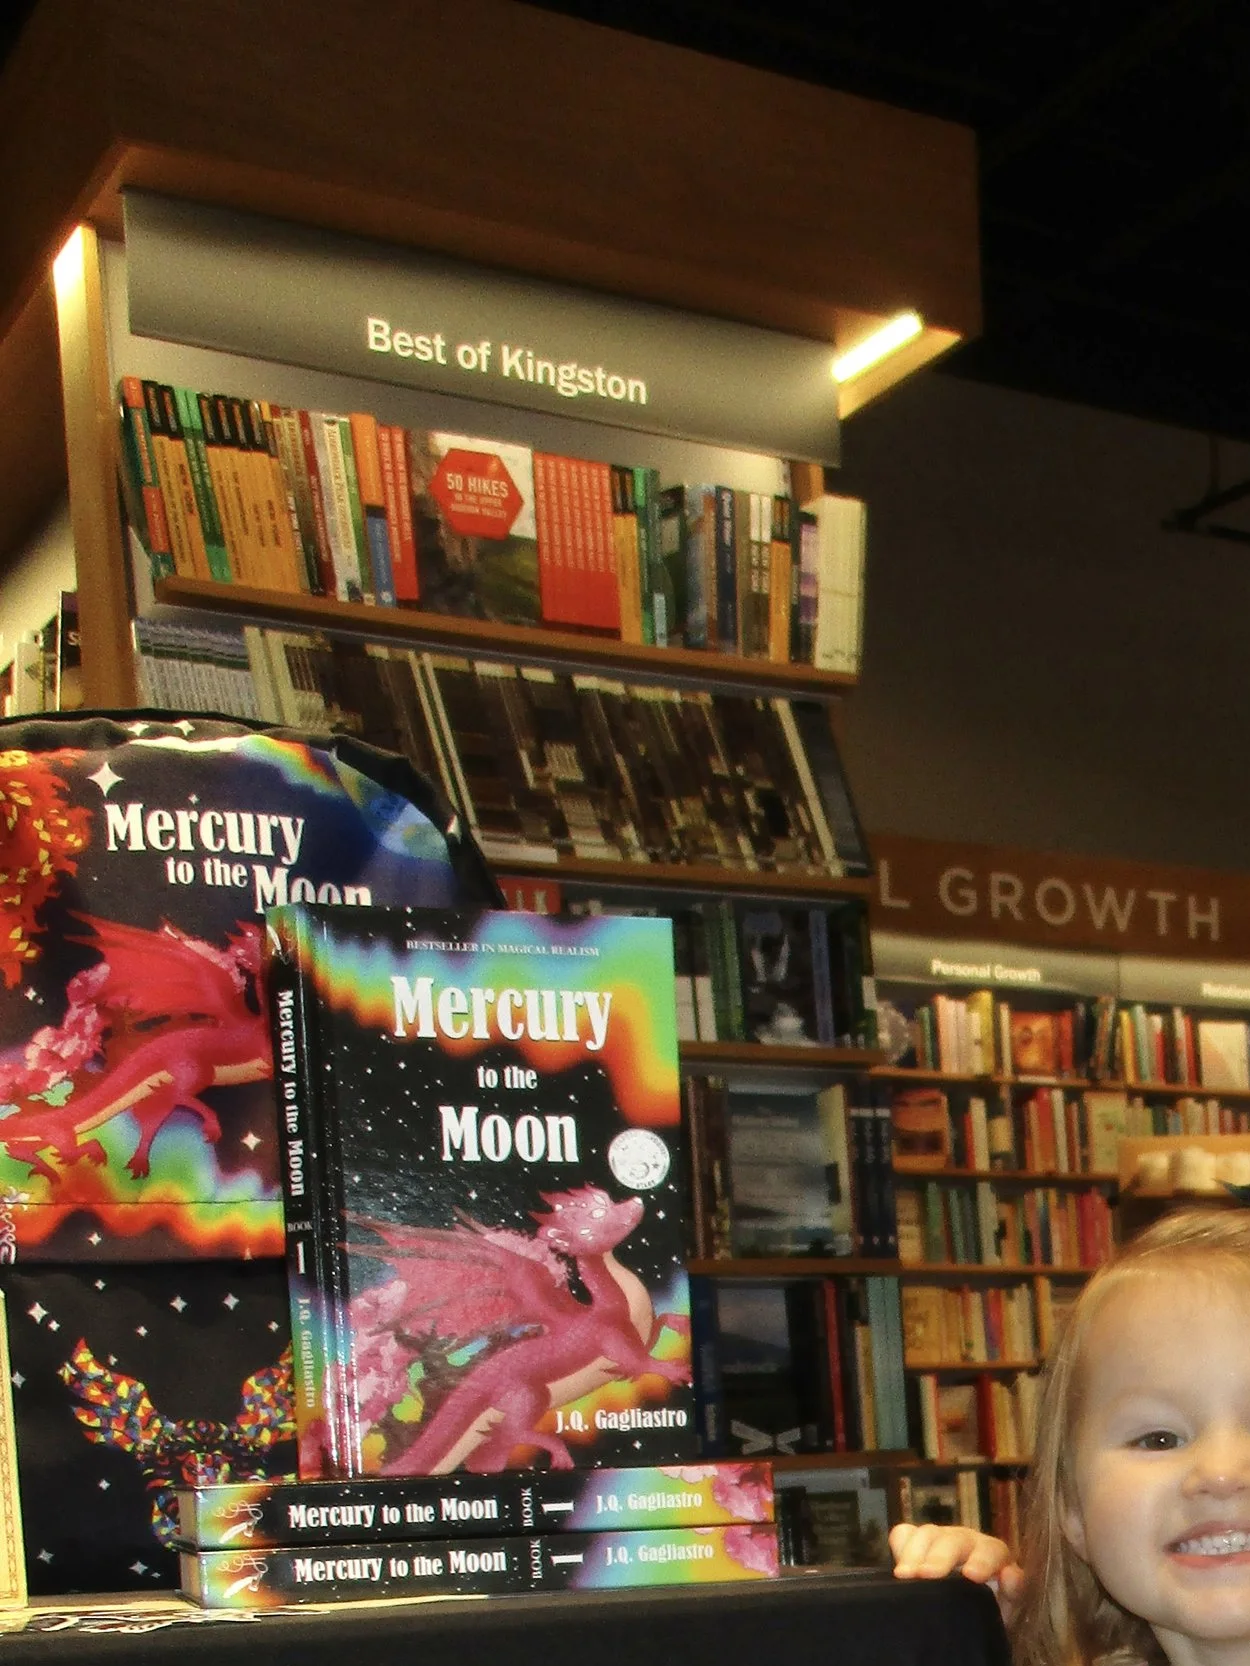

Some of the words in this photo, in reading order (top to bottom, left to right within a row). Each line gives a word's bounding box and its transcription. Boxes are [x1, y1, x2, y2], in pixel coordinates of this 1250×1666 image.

[367, 316, 448, 366] Best
[456, 341, 492, 373] of
[501, 344, 648, 405] Kingston
[446, 472, 464, 492] 50
[467, 476, 509, 499] HIKES
[104, 802, 305, 866] Mercury
[164, 856, 195, 885] to
[202, 857, 249, 888] the
[937, 866, 1221, 942] GROWTH
[406, 939, 479, 953] BESTSELLER
[481, 943, 495, 954] IN
[498, 943, 549, 956] MAGICAL
[551, 946, 600, 957] REALISM
[930, 959, 992, 979] Personal
[994, 964, 1042, 983] Growth
[389, 975, 613, 1051] Mercury
[278, 989, 297, 1074] Mercury
[284, 1082, 297, 1100] to
[476, 1064, 499, 1089] to
[503, 1064, 539, 1090] the
[285, 1104, 300, 1134] the
[438, 1104, 580, 1163] Moon
[287, 1139, 305, 1197] Moon
[287, 1220, 313, 1233] BOOK
[296, 1240, 306, 1275] 1
[300, 1329, 316, 1408] Gagliastro
[555, 1408, 590, 1434] J.Q.
[594, 1406, 688, 1432] Gagliastro
[288, 1503, 376, 1529] Mercury
[382, 1507, 401, 1525] to
[405, 1503, 436, 1524] the
[440, 1496, 499, 1522] Moon
[520, 1486, 534, 1528] BOOK
[540, 1501, 575, 1514] 1
[596, 1494, 624, 1514] J.Q.
[627, 1491, 703, 1512] Gagliastro
[293, 1557, 383, 1583] Mercury
[389, 1560, 409, 1578] to
[413, 1555, 444, 1576] the
[447, 1549, 508, 1575] Moon
[529, 1539, 544, 1580] BOOK
[550, 1552, 584, 1566] 1
[605, 1546, 634, 1566] J.Q.
[637, 1542, 715, 1563] Gagliastro
